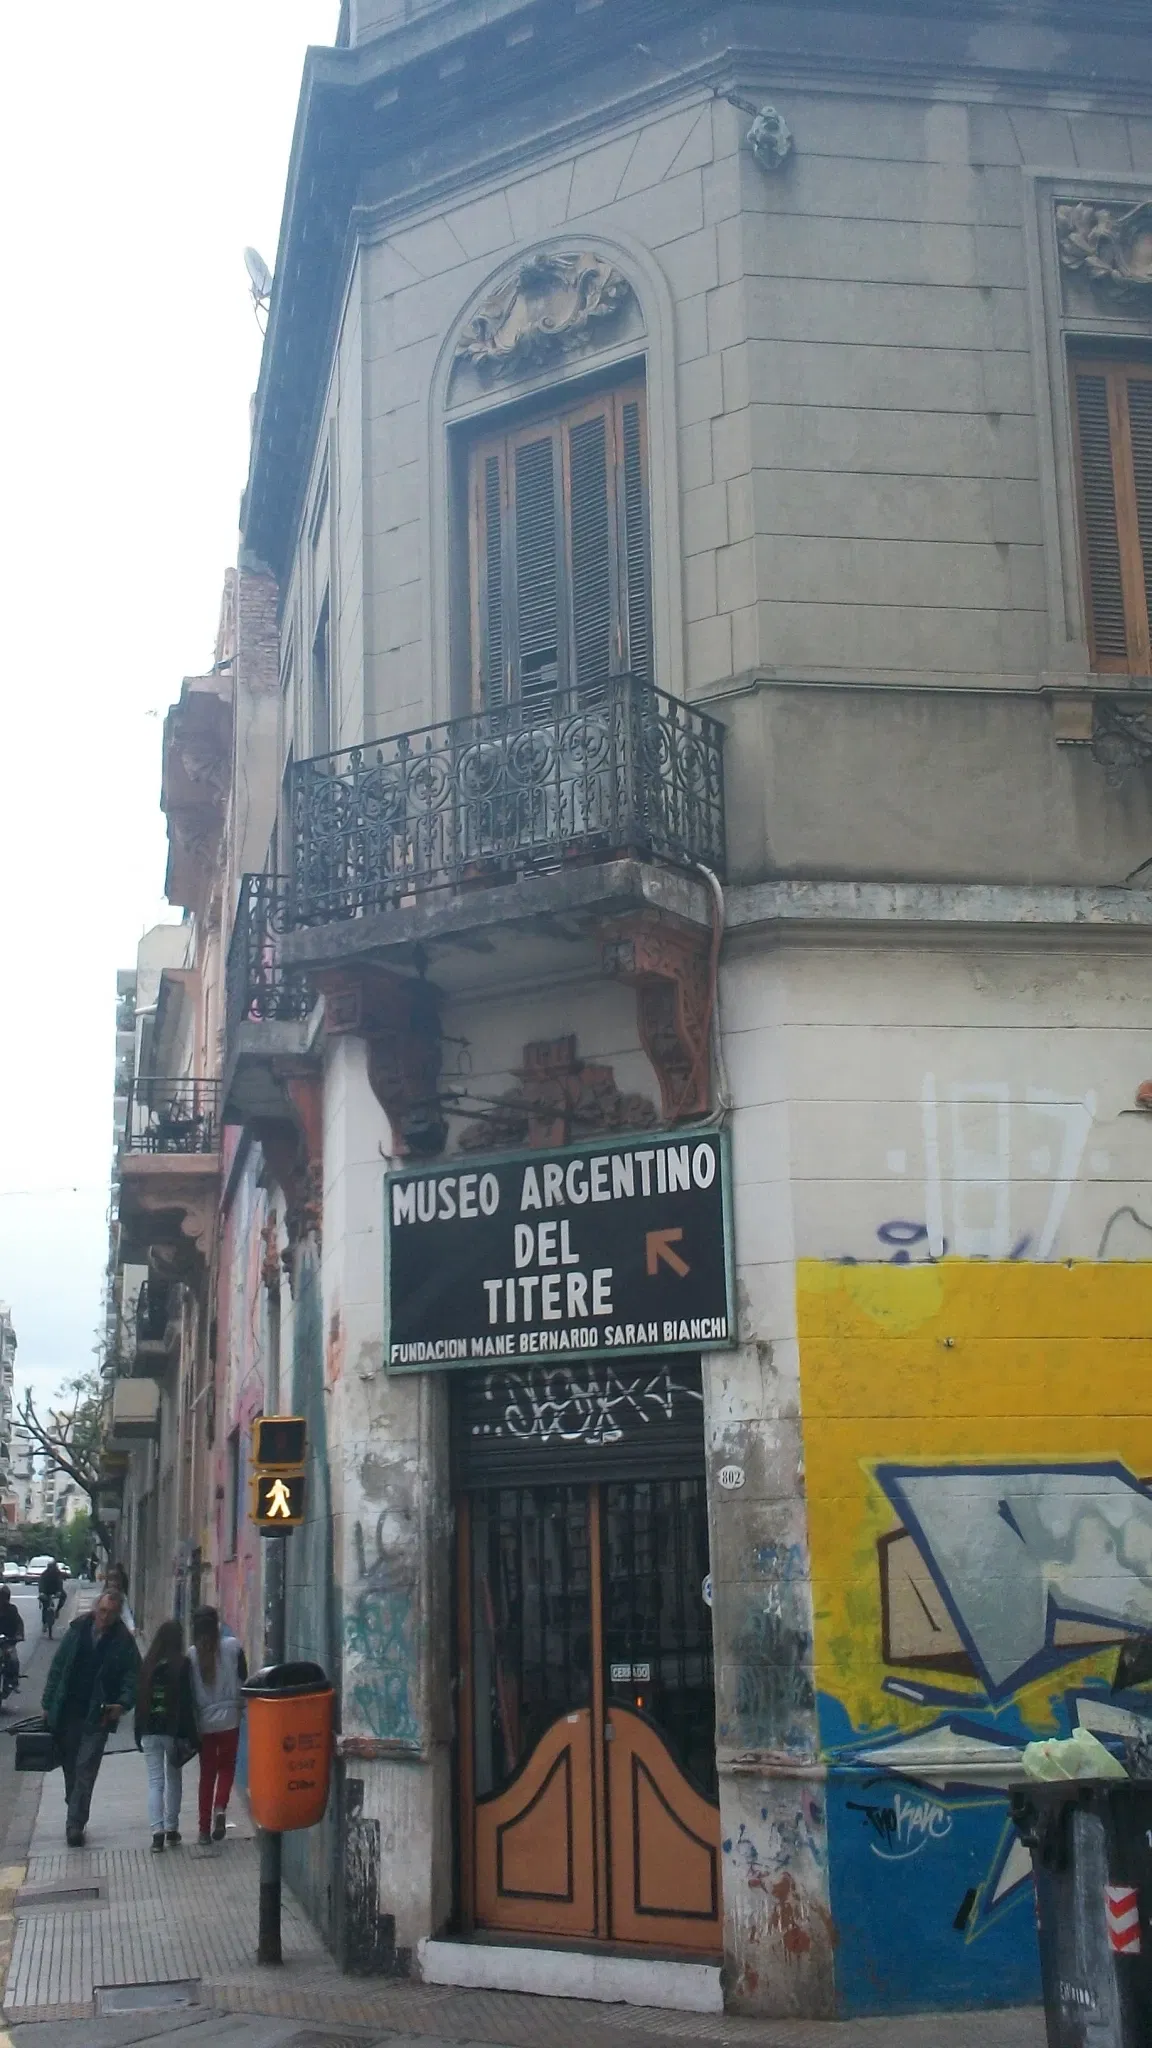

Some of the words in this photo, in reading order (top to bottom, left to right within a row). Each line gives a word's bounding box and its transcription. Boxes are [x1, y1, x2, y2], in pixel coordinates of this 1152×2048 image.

[392, 1172, 500, 1226] MUSEO
[520, 1142, 716, 1212] ARGENTINO
[514, 1219, 580, 1269] DEL
[483, 1268, 614, 1325] TITERE
[391, 1338, 467, 1364] FUNDACION
[471, 1333, 516, 1357] MANE
[519, 1327, 598, 1353] BERNARDO
[604, 1321, 659, 1346] SARAH
[663, 1316, 727, 1342] BIANCHI
[722, 1470, 741, 1485] 802
